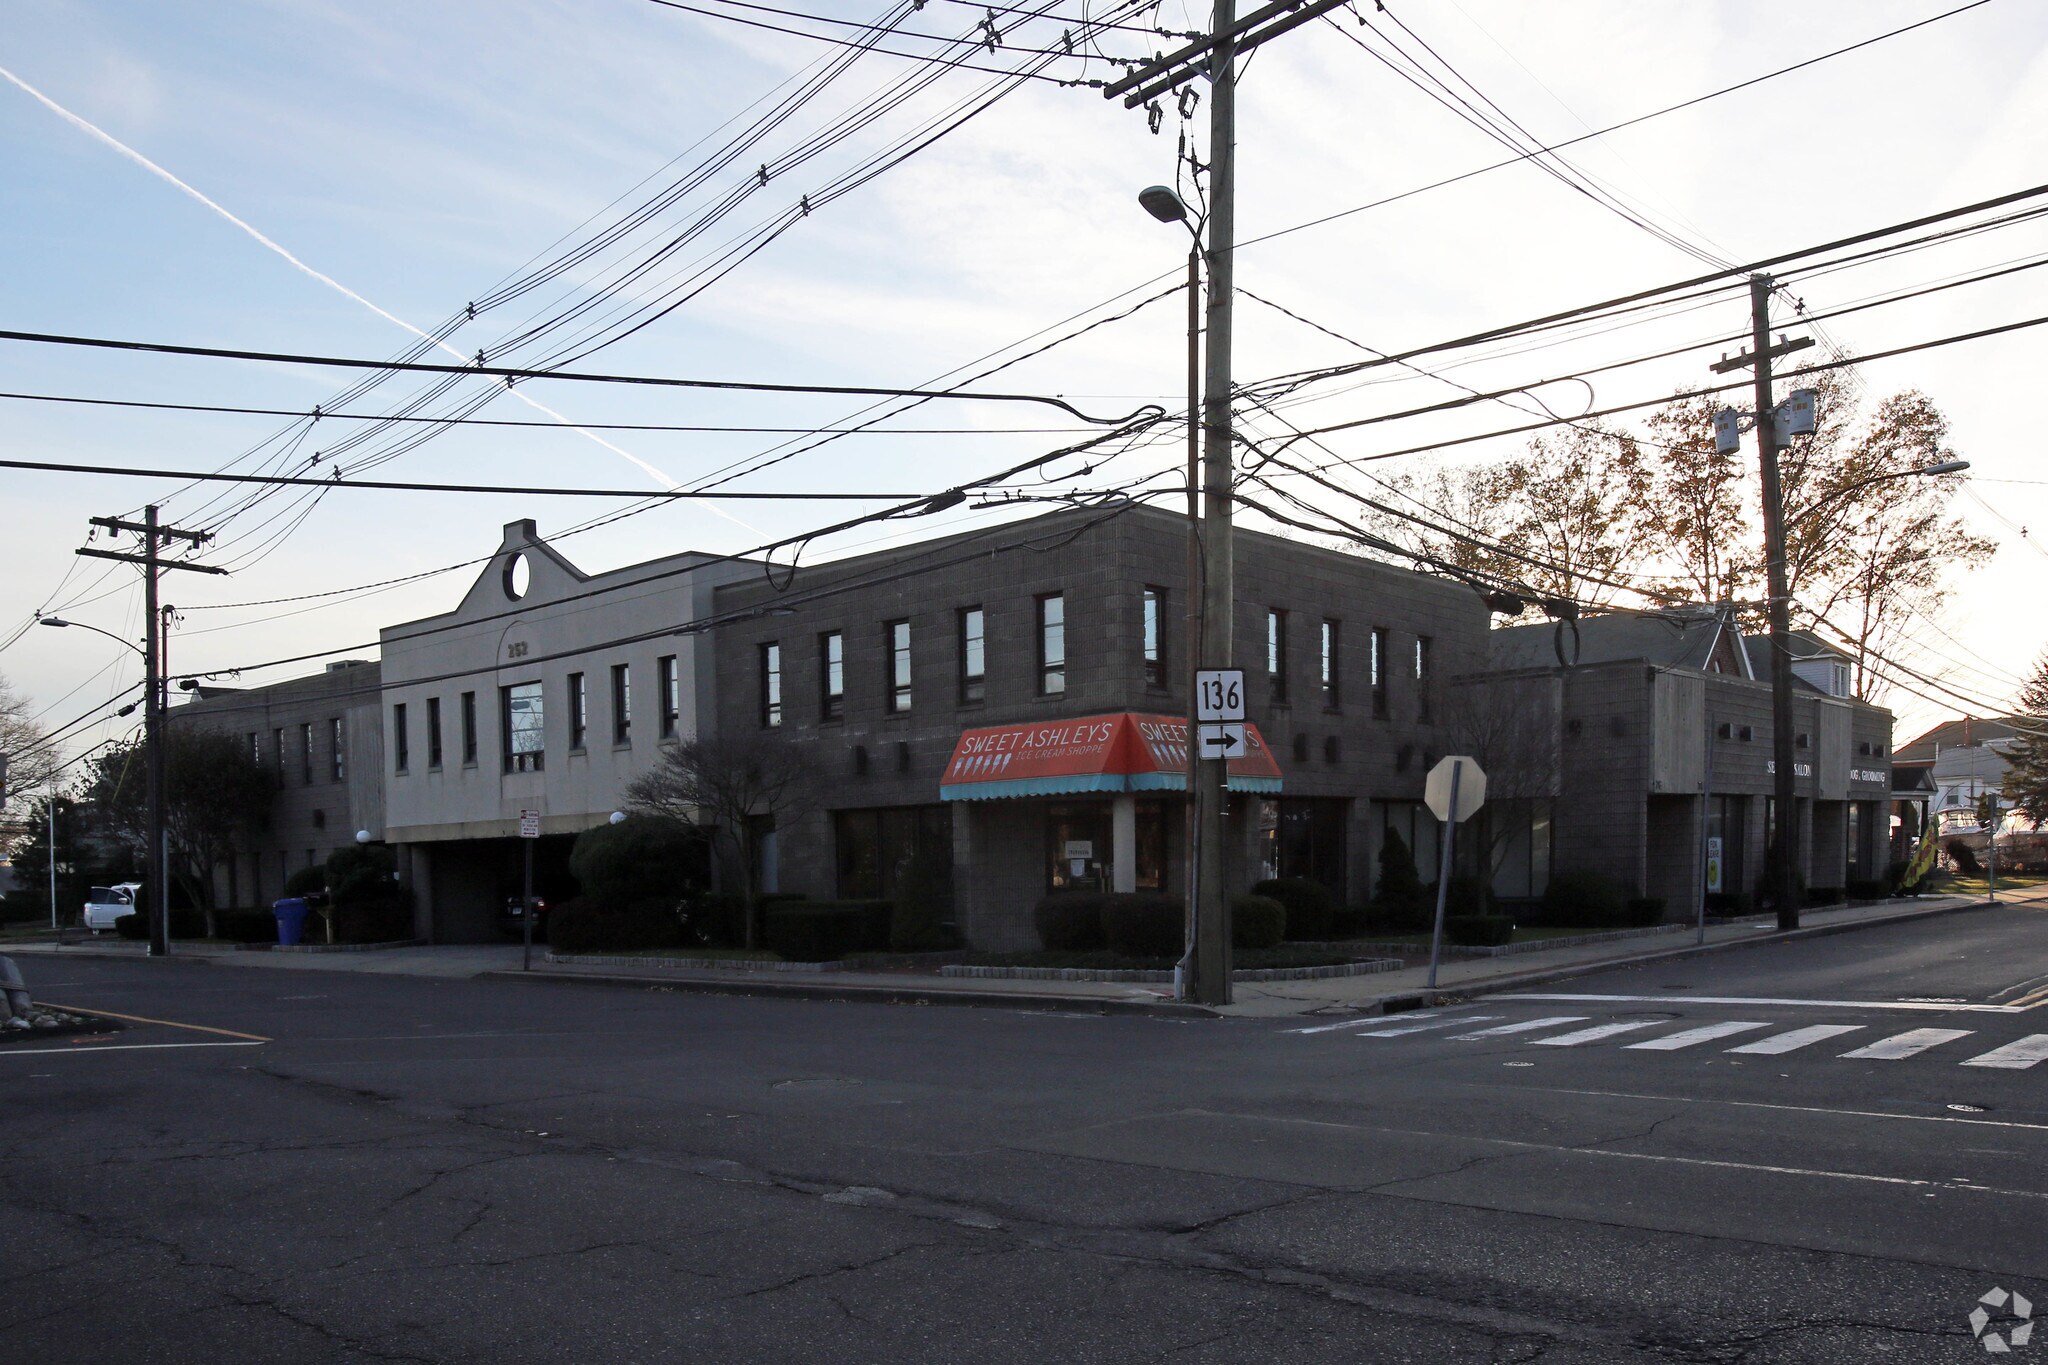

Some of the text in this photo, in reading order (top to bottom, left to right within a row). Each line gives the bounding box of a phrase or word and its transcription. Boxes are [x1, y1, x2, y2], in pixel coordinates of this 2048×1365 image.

[1203, 681, 1239, 710] 136
[962, 722, 1112, 754] SWEET ASHLEY'S
[1015, 743, 1104, 760] ICE CREAM SHOPPE
